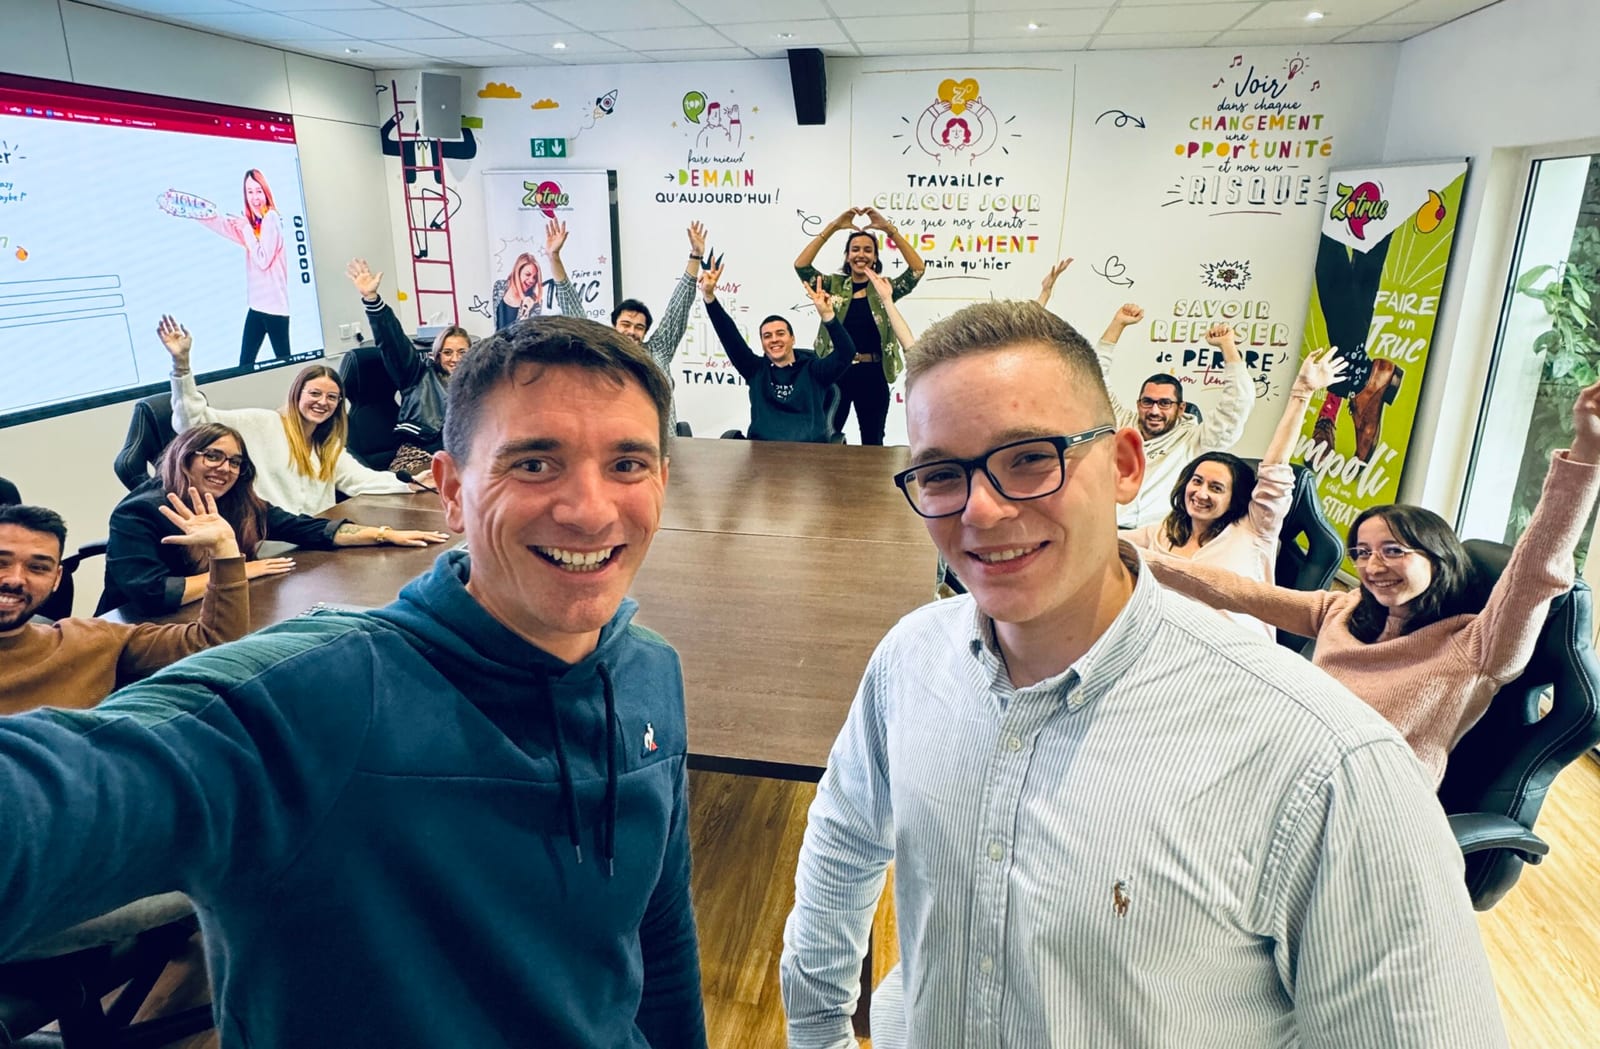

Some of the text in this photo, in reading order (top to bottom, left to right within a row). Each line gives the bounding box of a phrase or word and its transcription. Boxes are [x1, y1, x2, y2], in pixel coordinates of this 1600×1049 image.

[1217, 97, 1302, 115] dans chaque
[1189, 114, 1324, 131] CHANGEMENT
[1225, 134, 1249, 142] une
[687, 149, 711, 170] faire
[1218, 157, 1284, 173] et non un
[678, 169, 754, 187] DEMAIN
[1188, 175, 1311, 205] RISQUE
[873, 192, 1041, 213] CHAQUE JOUR
[900, 217, 915, 226] ce
[921, 218, 946, 231] que
[953, 218, 976, 229] nos
[981, 212, 1026, 228] clients
[571, 269, 591, 279] Faire
[1173, 299, 1271, 319] SAVOIR
[1374, 290, 1440, 315] FAIRE
[1398, 318, 1415, 331] un
[1365, 315, 1427, 362] TRUC
[1156, 348, 1274, 372] de PERRE
